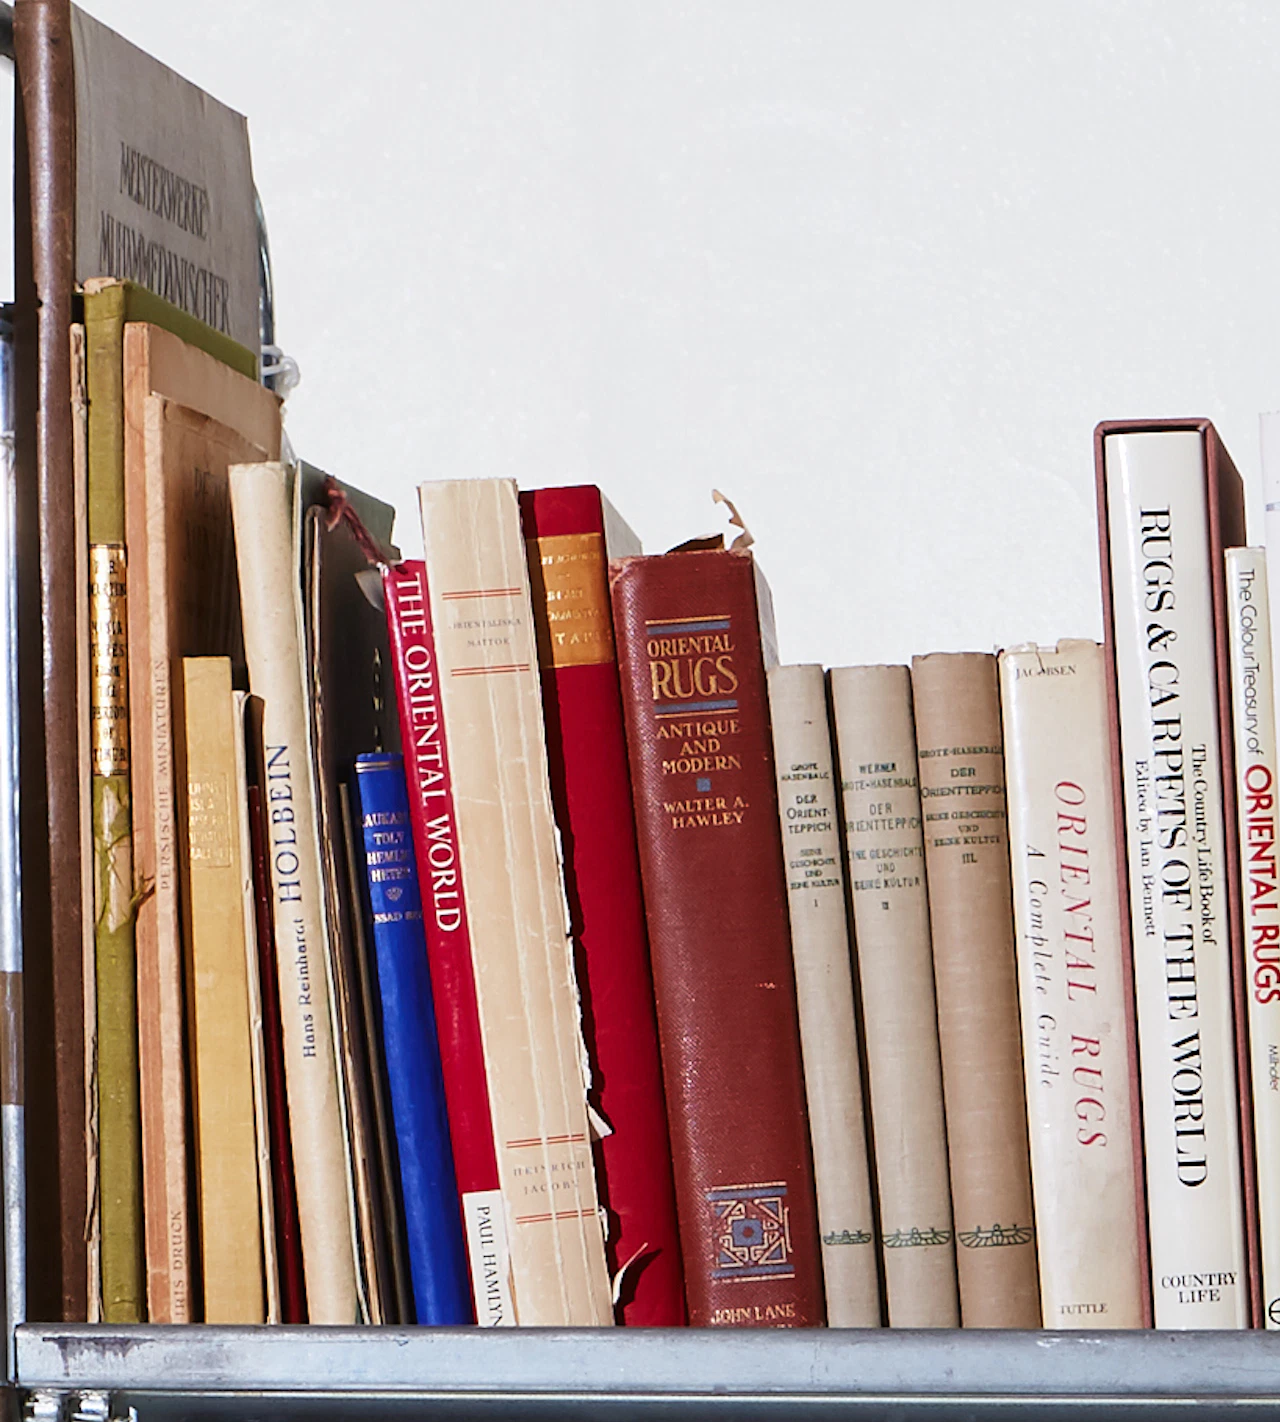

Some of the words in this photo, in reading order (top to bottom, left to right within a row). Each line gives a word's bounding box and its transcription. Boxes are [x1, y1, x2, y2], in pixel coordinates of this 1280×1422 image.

[1139, 507, 1176, 614] RUGS
[395, 573, 425, 636] THE
[645, 639, 735, 658] ORIENTAL
[1147, 624, 1179, 651] &
[651, 661, 738, 702] RUGS
[402, 646, 444, 808] ORIENTAL
[657, 719, 741, 743] ANTIQUE
[678, 741, 722, 756] AND
[660, 756, 742, 774] MODERN
[1149, 661, 1188, 852] CARPETS
[266, 744, 302, 903] HOLBEIN
[660, 798, 729, 815] WALTER
[732, 795, 750, 810] A.
[669, 813, 743, 830] HAWLEY
[427, 817, 462, 933] WORLD
[1159, 861, 1191, 912] OF
[1163, 923, 1196, 1022] THE
[1170, 1031, 1208, 1188] WORLD
